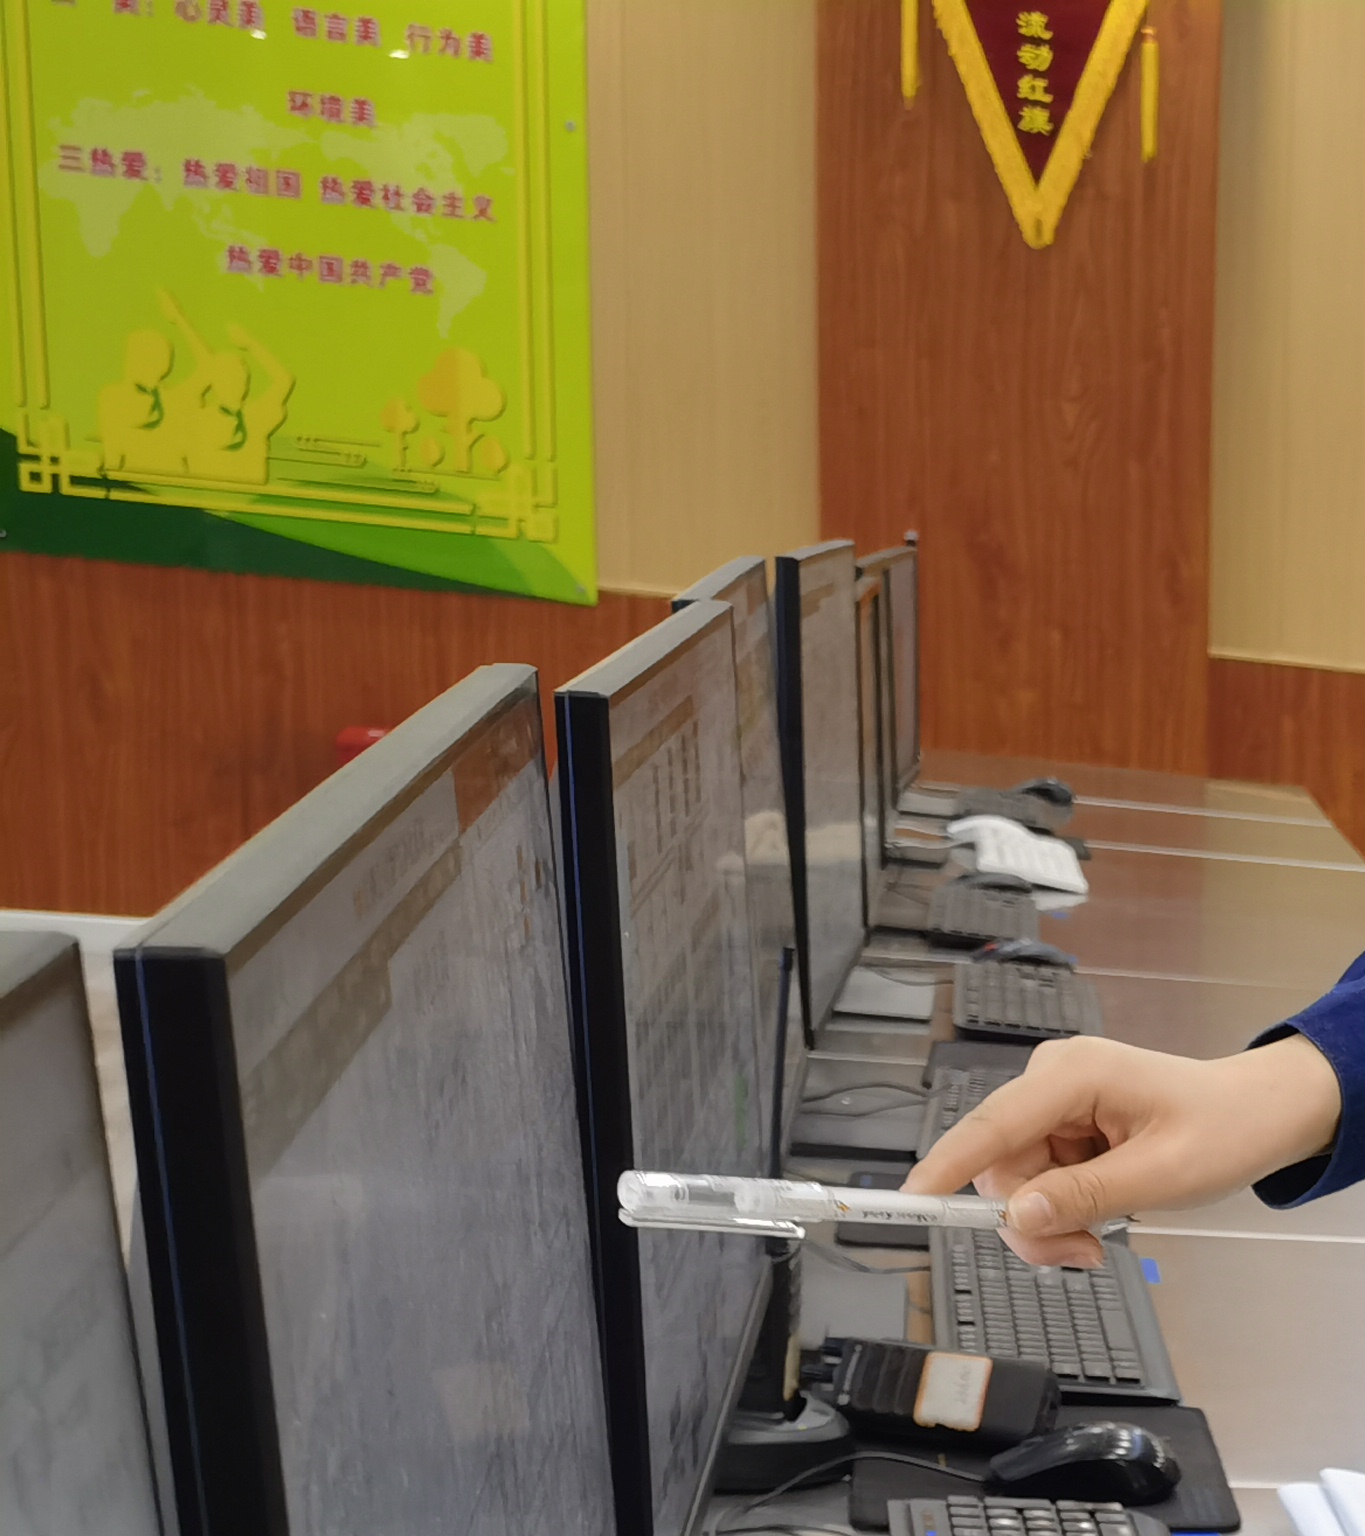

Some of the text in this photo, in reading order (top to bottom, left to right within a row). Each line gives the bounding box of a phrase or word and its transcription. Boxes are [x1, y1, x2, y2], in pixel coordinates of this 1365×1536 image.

[292, 7, 380, 48] 语言美
[405, 23, 494, 63] 行为美
[286, 90, 376, 128] 环境美
[319, 175, 496, 223] 热爱社会主义
[226, 244, 435, 295] 热爱中国共产党
